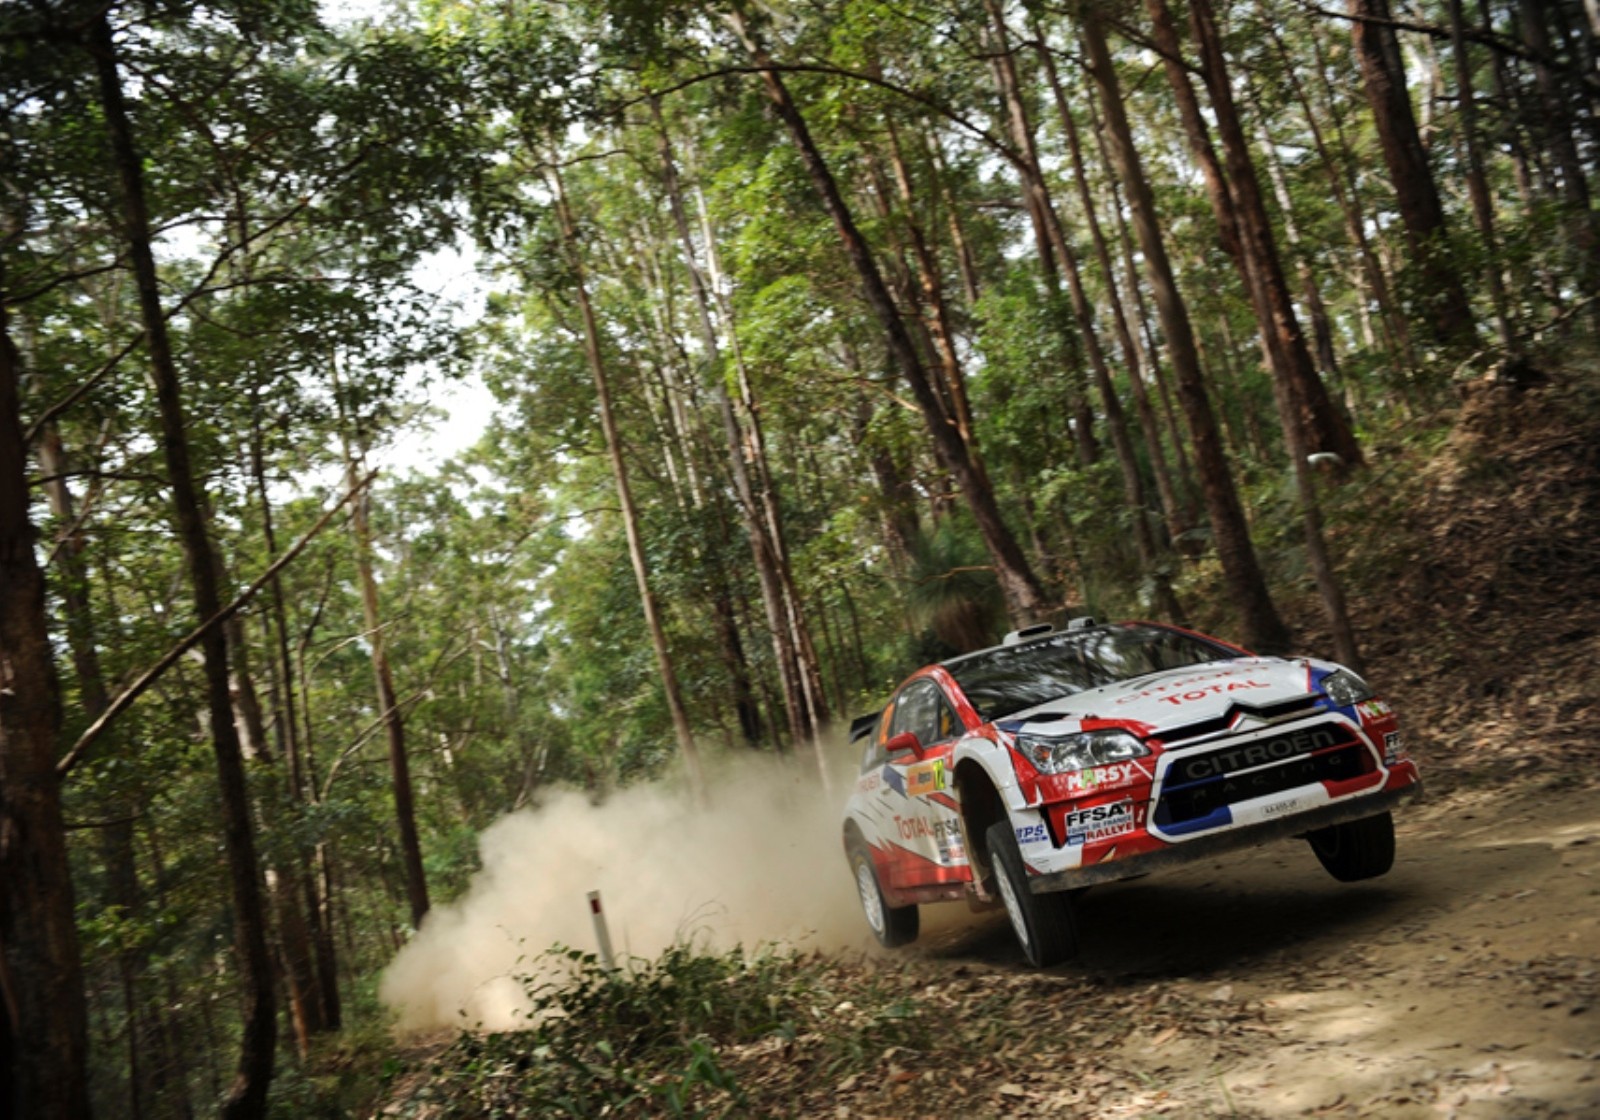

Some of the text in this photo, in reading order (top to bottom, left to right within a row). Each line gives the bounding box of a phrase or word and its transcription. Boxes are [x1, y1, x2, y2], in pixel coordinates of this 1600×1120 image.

[1158, 680, 1270, 705] TOTAL
[1067, 764, 1132, 792] MARSY
[1066, 803, 1125, 827] FFSA
[893, 815, 936, 841] TOTAL
[1086, 821, 1133, 841] RALLYE
